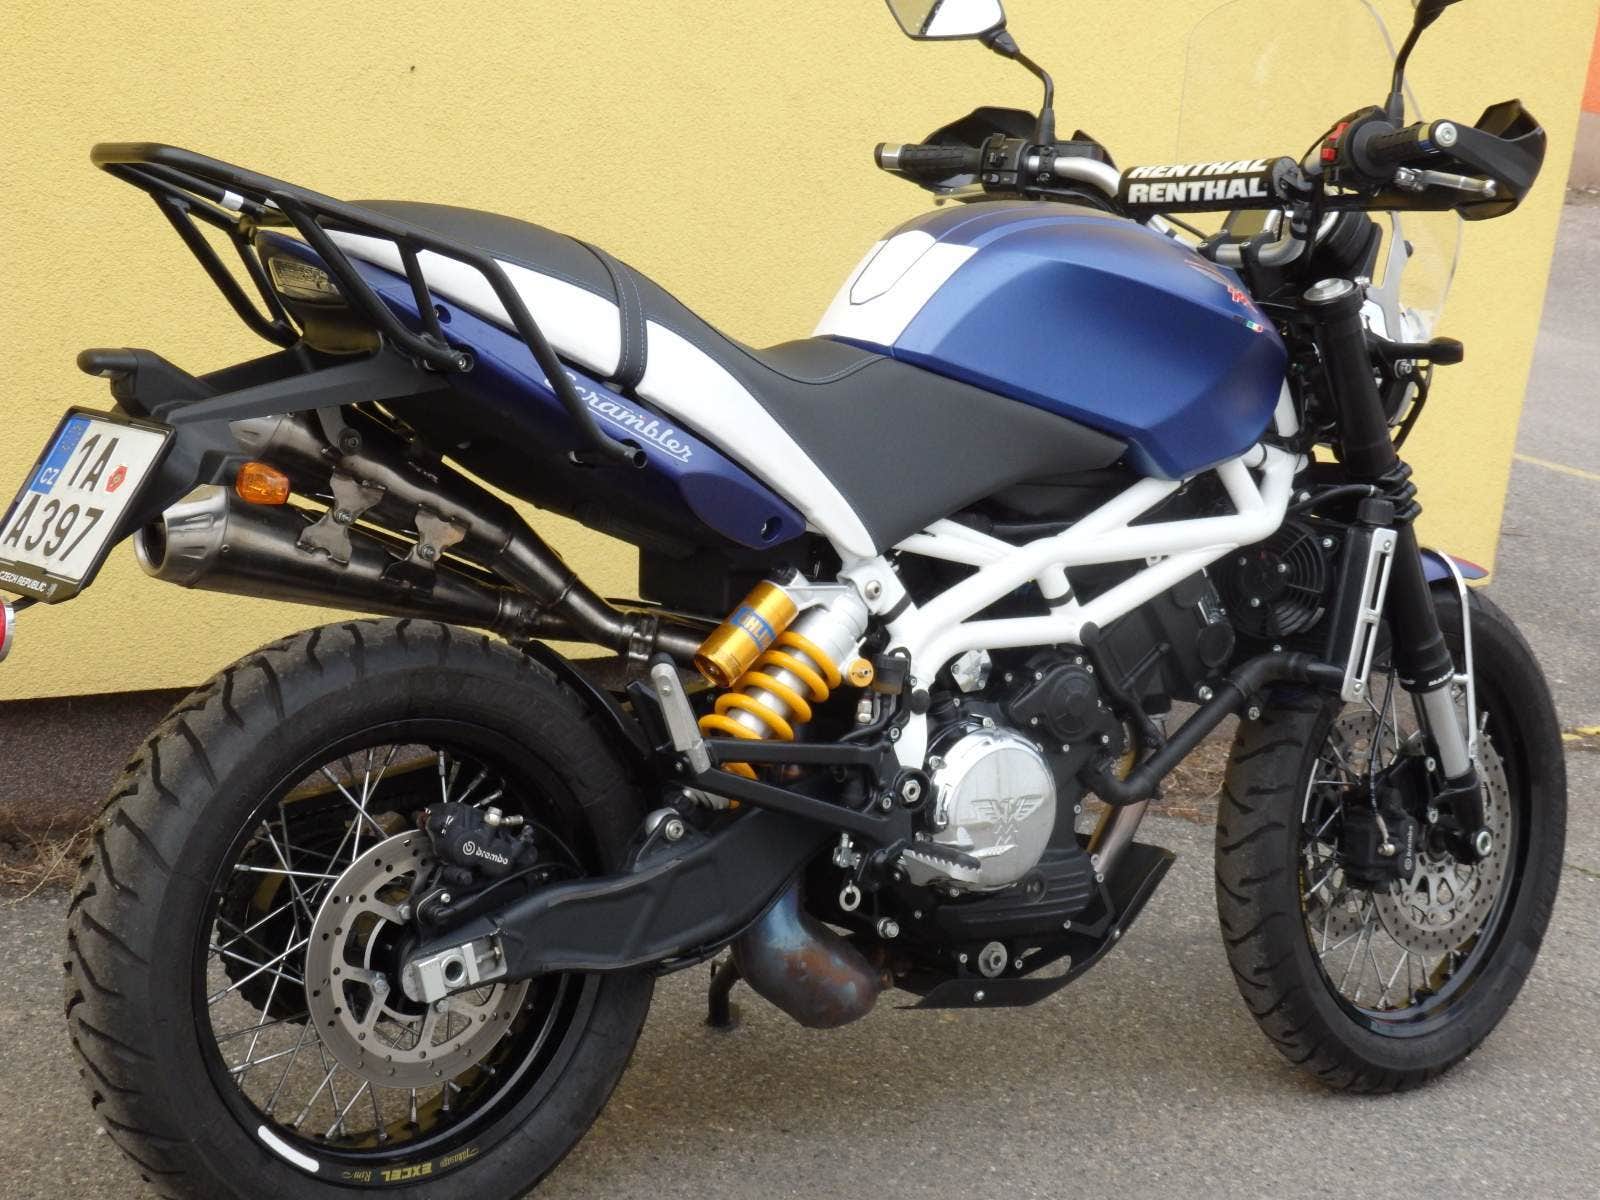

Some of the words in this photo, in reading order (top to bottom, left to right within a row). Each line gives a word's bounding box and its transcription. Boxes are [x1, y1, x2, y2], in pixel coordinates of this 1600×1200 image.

[1127, 177, 1268, 204] RENTHAL
[68, 433, 120, 492] 1A
[39, 467, 57, 485] CZ
[3, 494, 104, 562] A397
[16, 575, 48, 592] REPUBLIC
[475, 846, 509, 865] brembo
[381, 1161, 433, 1182] EXCEL
